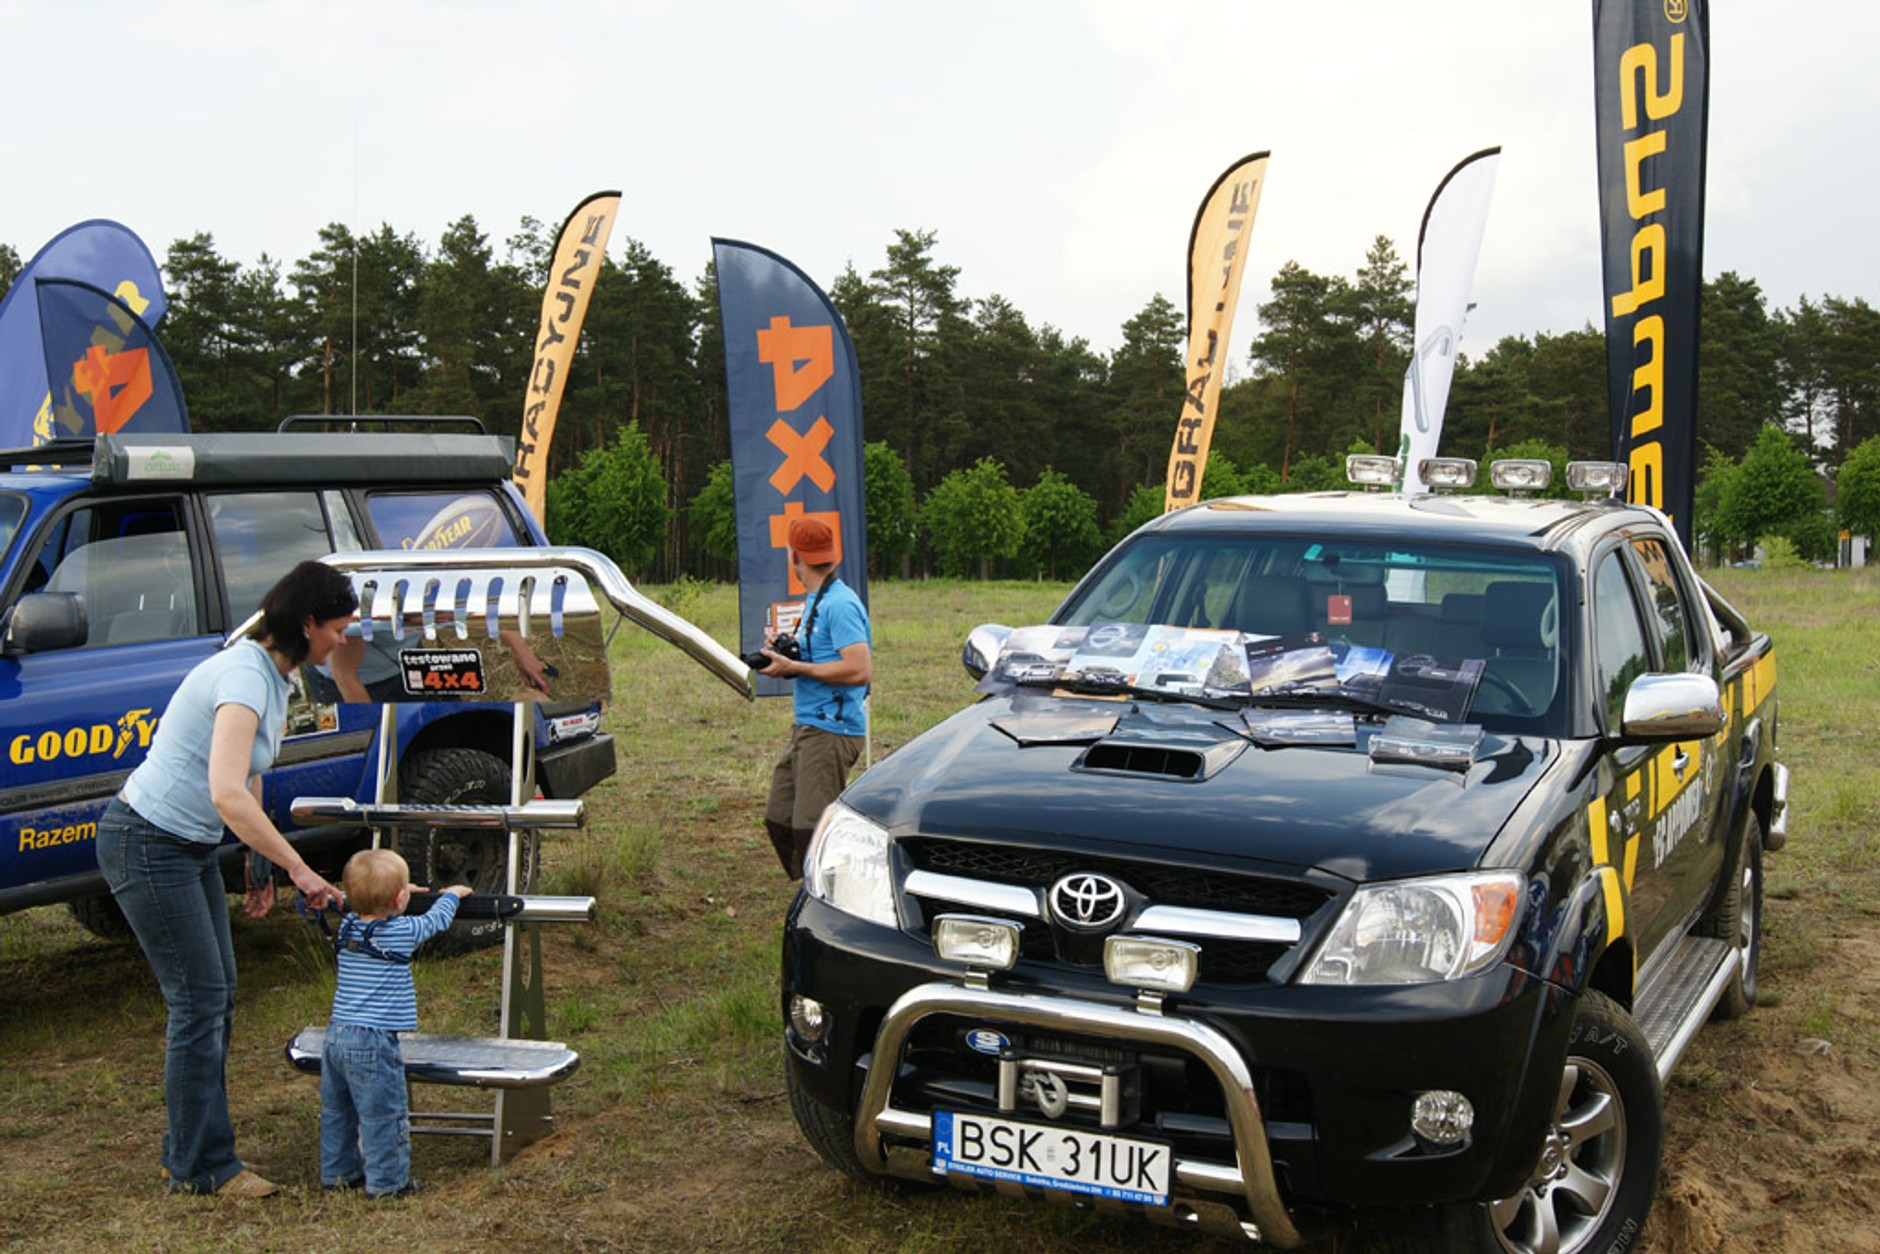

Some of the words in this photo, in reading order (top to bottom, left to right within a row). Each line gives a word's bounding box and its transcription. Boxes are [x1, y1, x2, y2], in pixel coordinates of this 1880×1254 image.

[403, 652, 477, 665] testowane
[424, 671, 481, 690] 4x4
[9, 712, 160, 765] GOODY
[18, 821, 97, 853] Razem
[937, 1141, 951, 1155] PL
[960, 1120, 1044, 1172] BSK
[1061, 1135, 1161, 1190] 31UK
